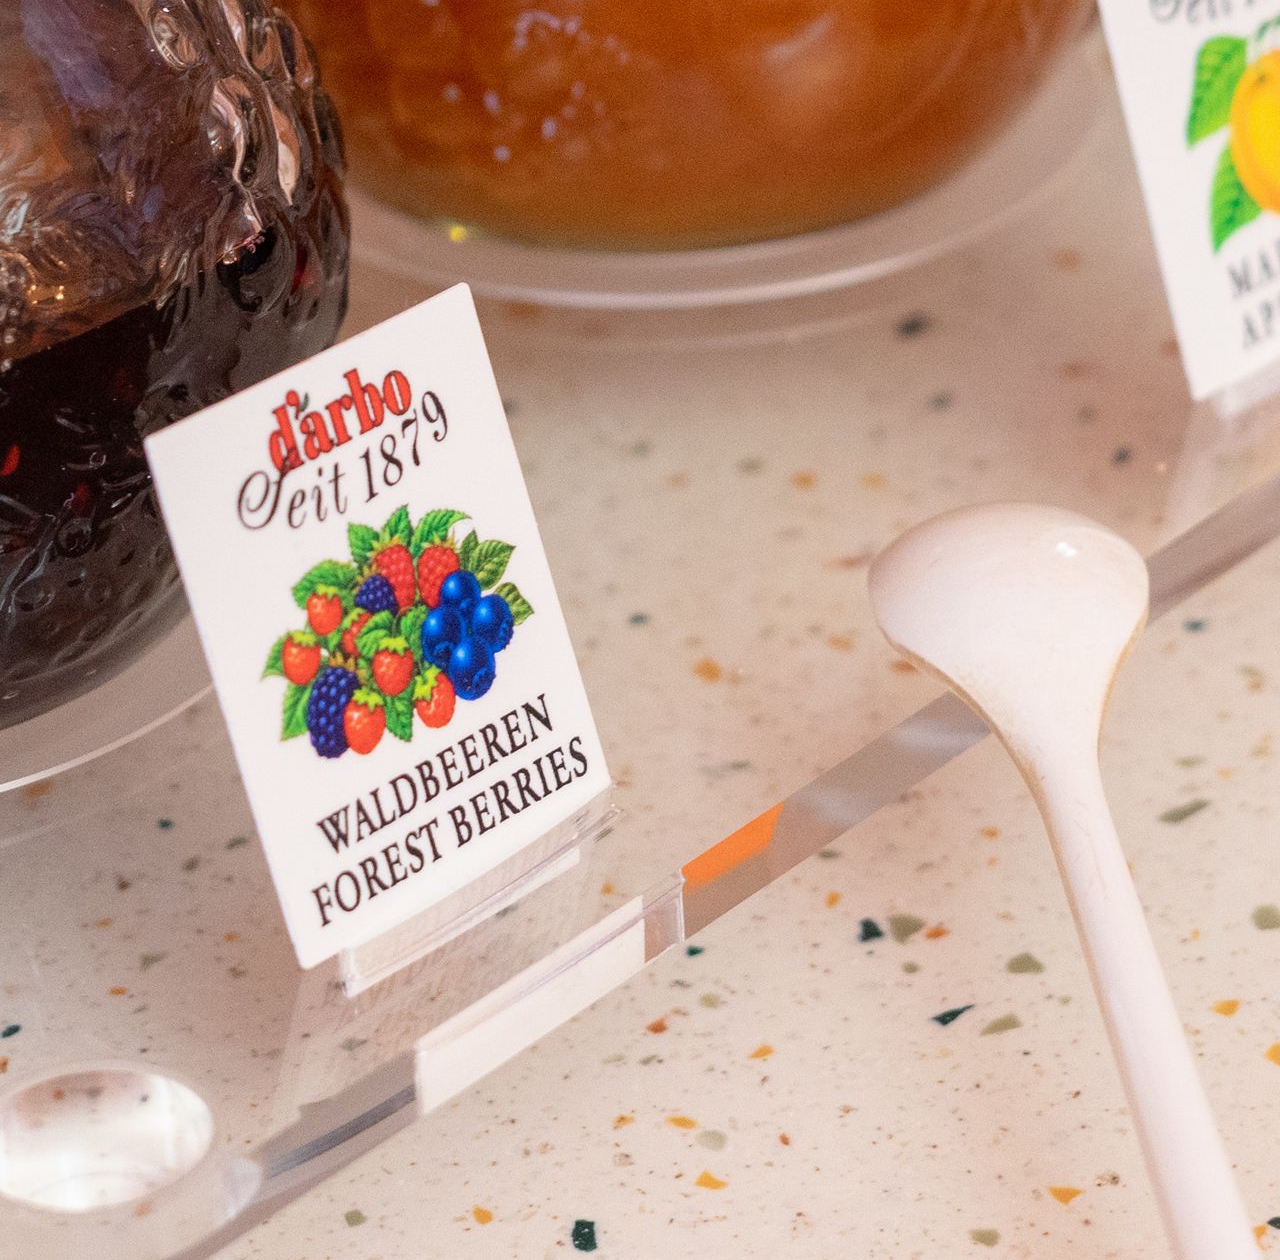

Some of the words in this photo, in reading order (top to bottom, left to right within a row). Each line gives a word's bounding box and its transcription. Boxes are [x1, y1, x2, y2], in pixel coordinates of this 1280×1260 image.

[237, 446, 348, 530] Seit
[359, 390, 449, 503] 1879
[311, 816, 443, 928] FOREST
[447, 735, 588, 849] BERRIES
[316, 692, 554, 855] WALDBEEREN
